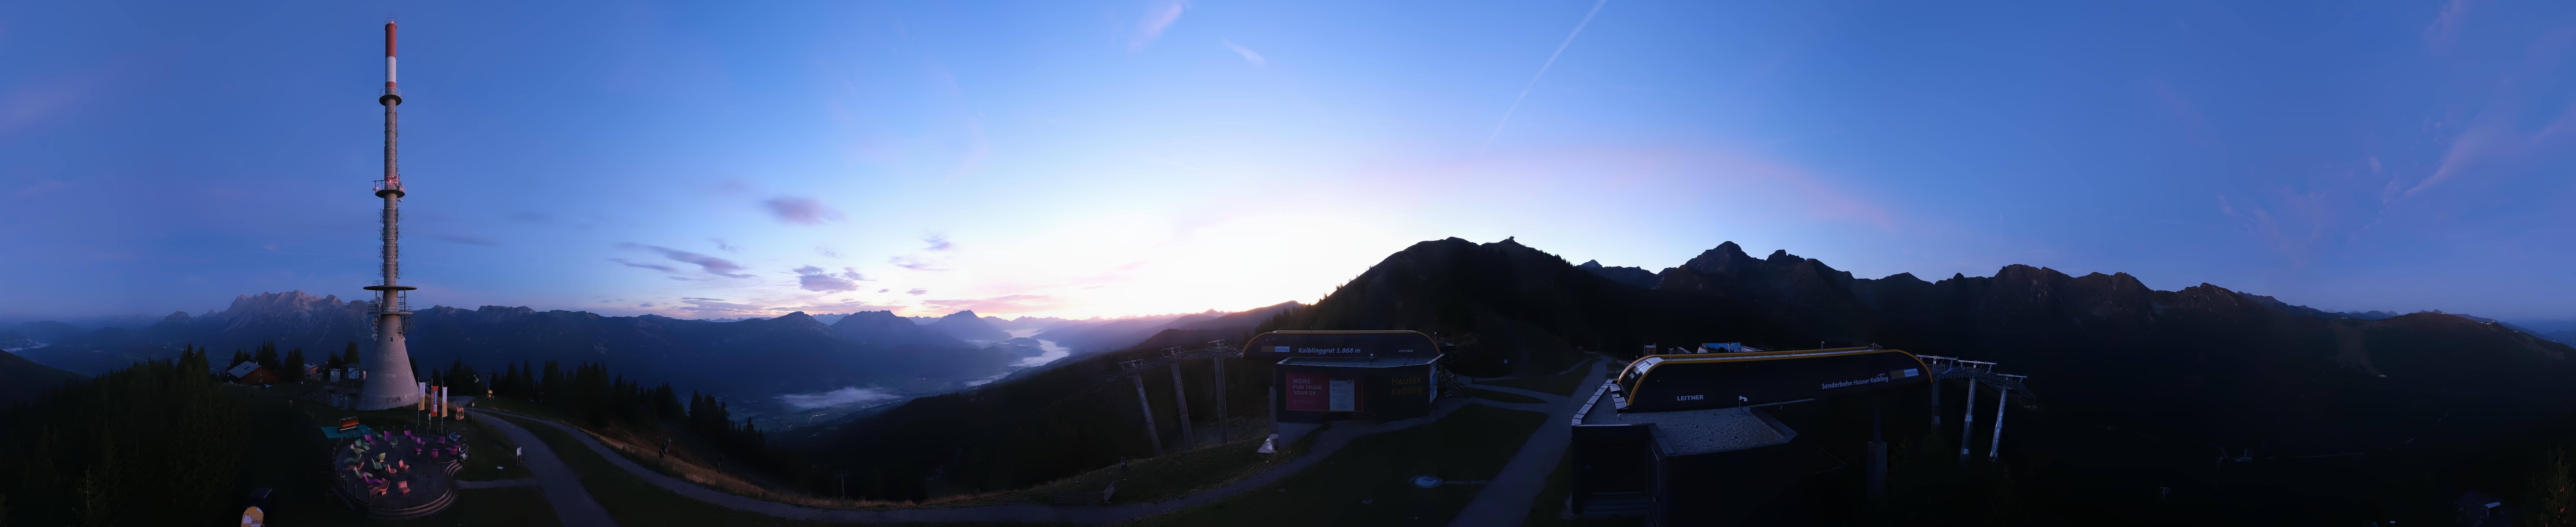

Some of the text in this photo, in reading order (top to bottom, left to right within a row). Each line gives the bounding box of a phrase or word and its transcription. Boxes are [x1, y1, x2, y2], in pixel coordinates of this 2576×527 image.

[1392, 377, 1421, 386] HAUSER
[1822, 380, 1852, 389] Senderbahn
[1391, 386, 1422, 396] Kaibling
